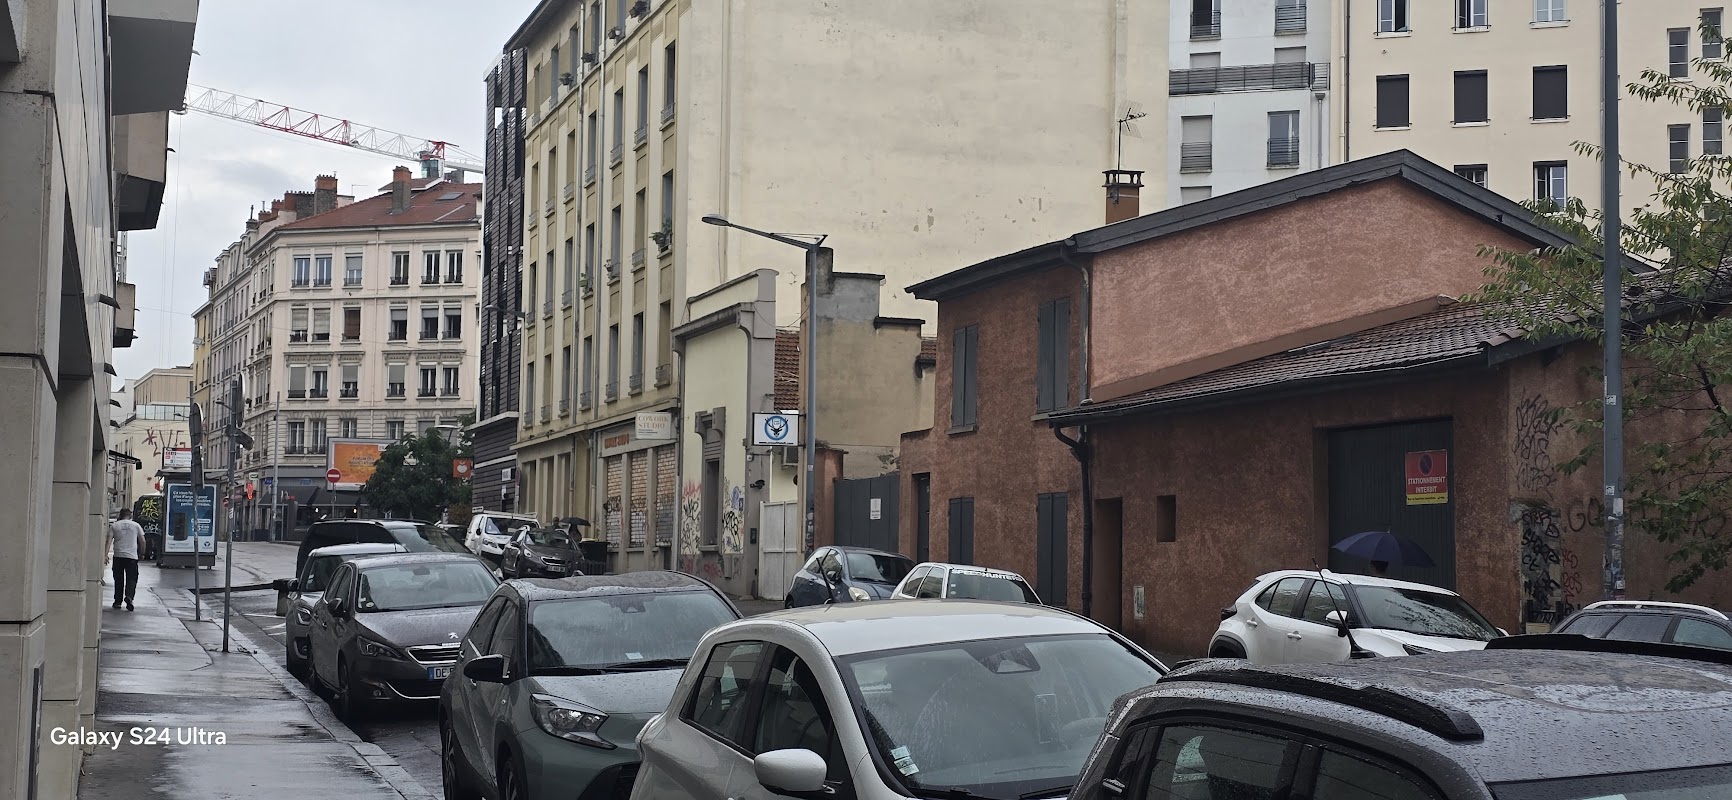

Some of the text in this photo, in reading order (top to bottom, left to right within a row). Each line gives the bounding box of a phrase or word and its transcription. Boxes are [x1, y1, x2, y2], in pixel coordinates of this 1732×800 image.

[1407, 476, 1446, 485] STATIONNEMENT
[1415, 485, 1438, 494] INTERDIT
[951, 569, 1023, 582] SPEEDHUNTERS
